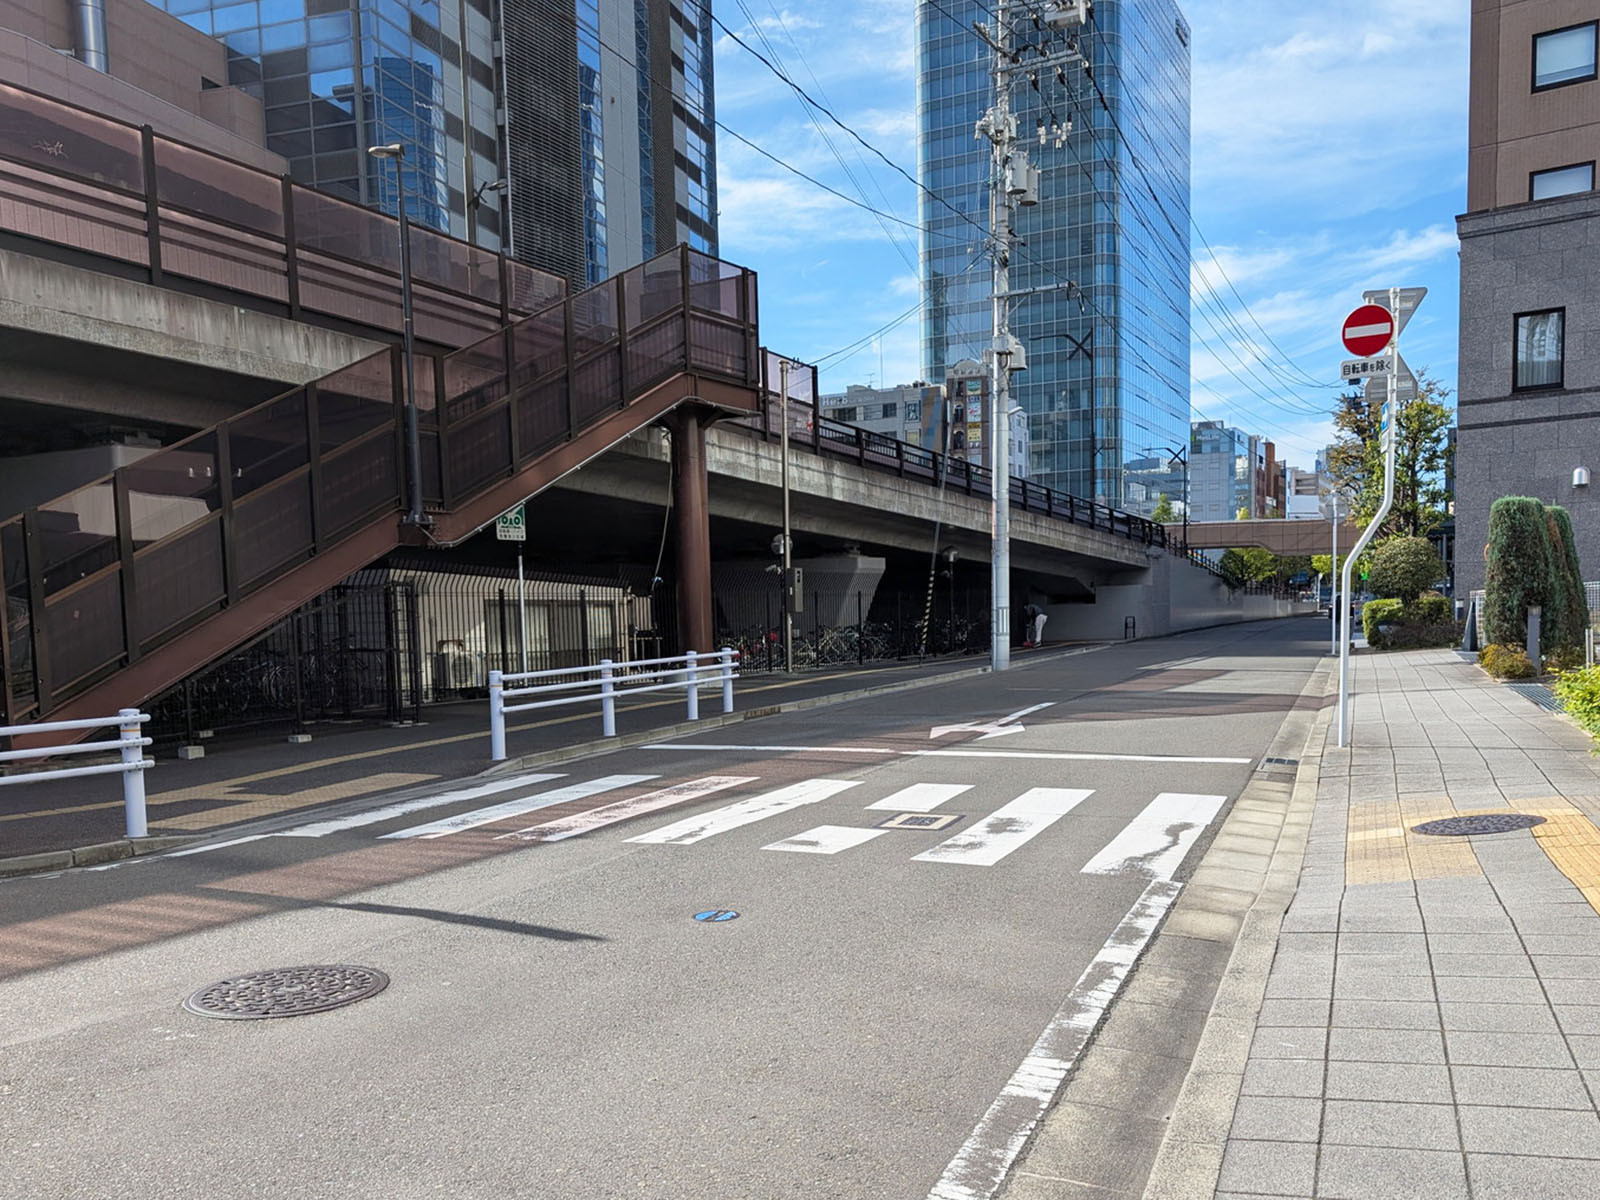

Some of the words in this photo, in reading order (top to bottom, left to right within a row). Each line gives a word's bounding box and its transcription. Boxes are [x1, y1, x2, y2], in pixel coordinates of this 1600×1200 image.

[1343, 360, 1391, 375] 自転車を除く
